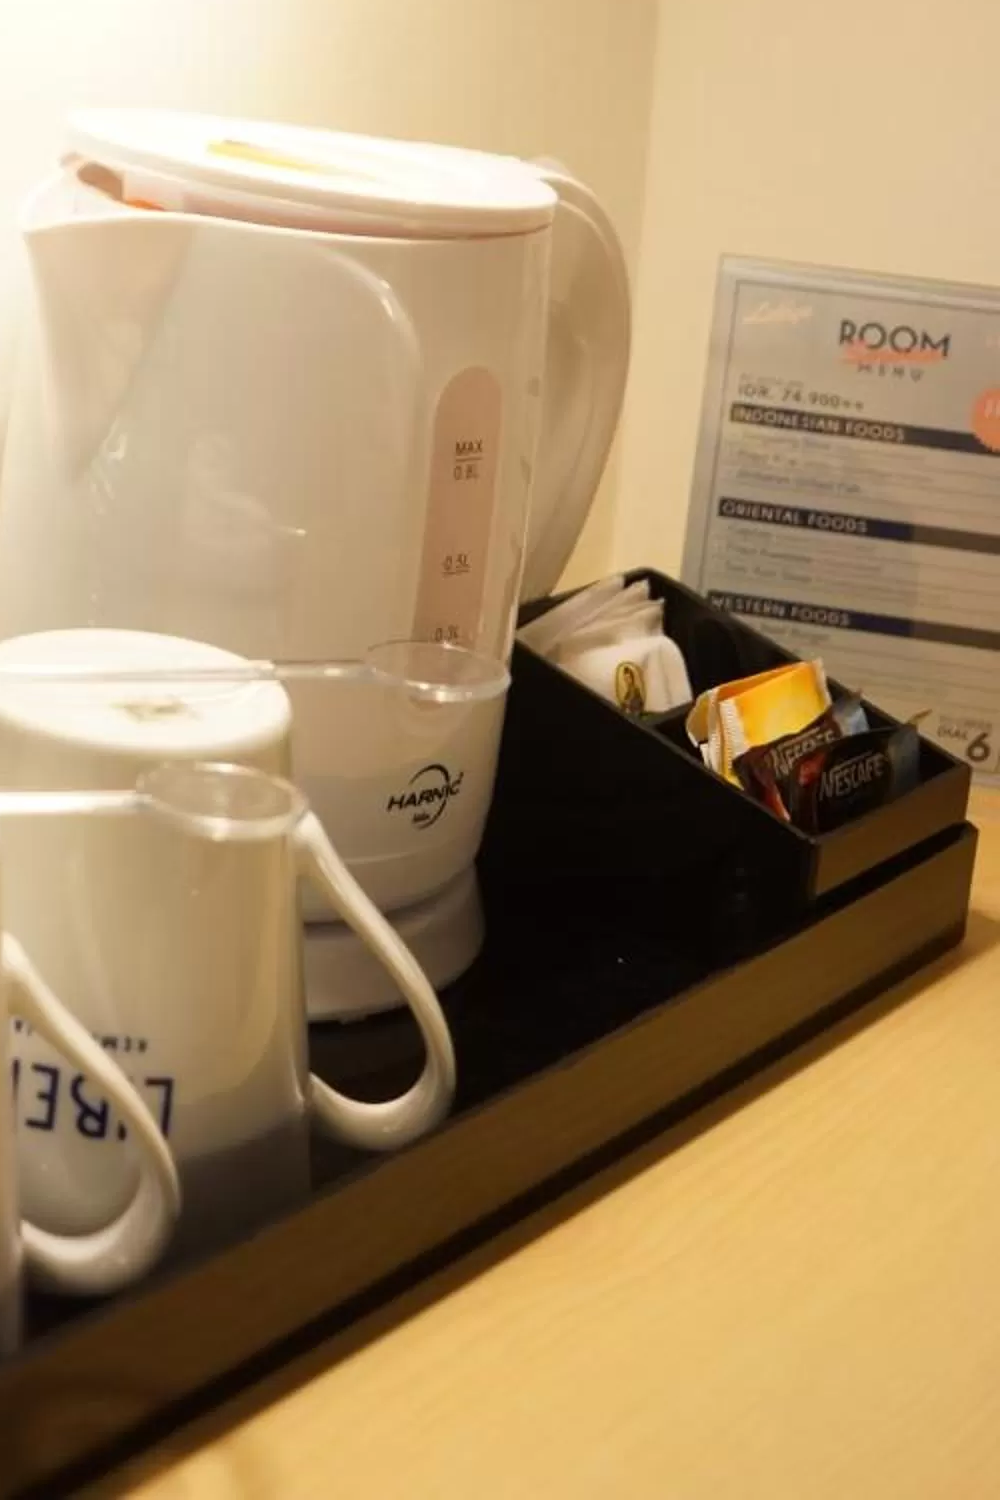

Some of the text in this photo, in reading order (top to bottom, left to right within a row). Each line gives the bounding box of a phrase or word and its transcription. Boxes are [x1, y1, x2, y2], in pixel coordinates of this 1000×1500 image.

[838, 318, 951, 360] ROOM
[857, 362, 924, 382] MENU
[735, 407, 905, 442] INDONESIAN FOODS
[455, 439, 483, 455] MAX
[721, 500, 868, 534] ORIENTAL FOODS
[711, 595, 850, 627] WESTERN FOODS
[967, 731, 991, 763] 6
